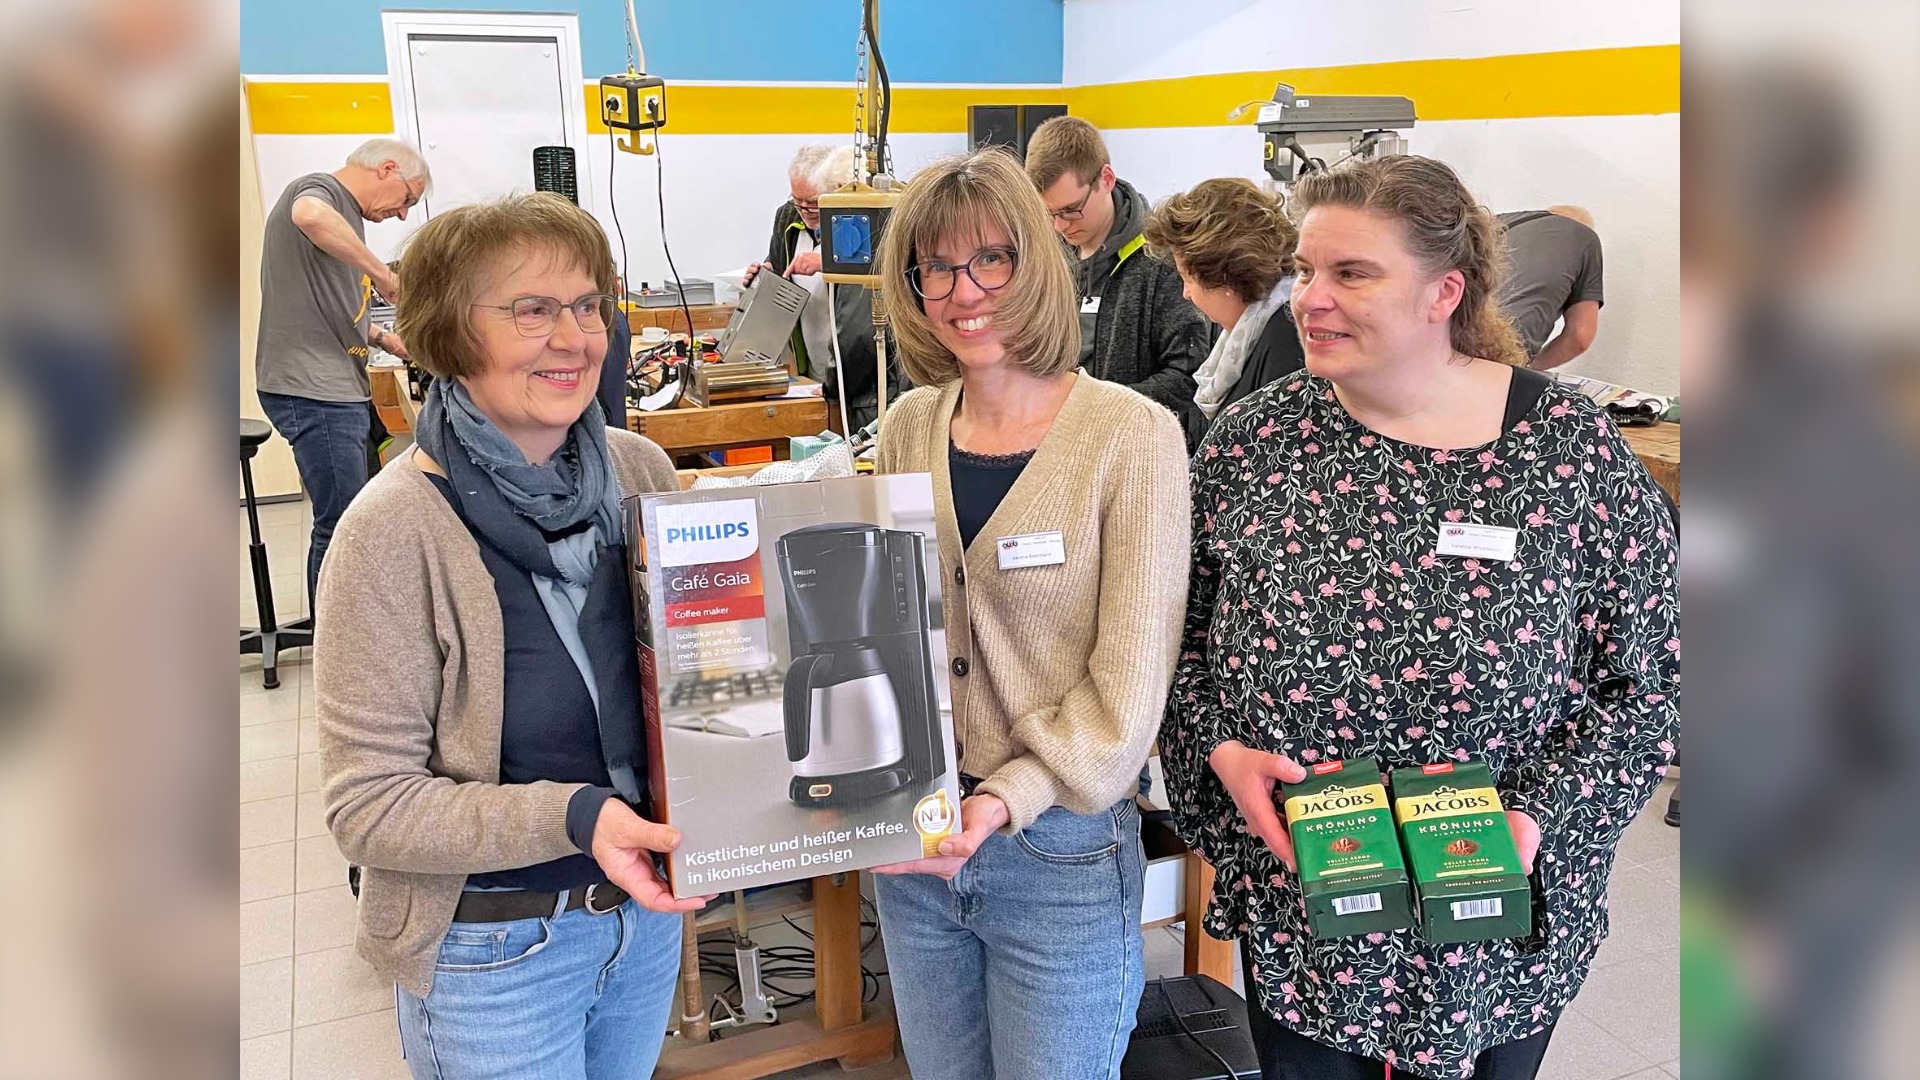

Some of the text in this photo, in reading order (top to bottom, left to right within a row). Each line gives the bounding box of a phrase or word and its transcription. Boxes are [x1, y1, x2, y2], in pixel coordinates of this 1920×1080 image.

[666, 521, 749, 544] PHILIPS
[671, 571, 751, 591] Café Gaia
[674, 606, 729, 619] Coffee maker
[677, 645, 755, 661] mehr als 2 Stunden
[1301, 792, 1375, 816] JACOBS
[1411, 795, 1490, 817] JACOBS
[1306, 815, 1377, 832] KRÖNUNG
[1419, 818, 1494, 834] KRÖNUNG
[685, 844, 766, 867] Köstlicher
[769, 836, 799, 853] und
[803, 830, 852, 848] heißer
[855, 822, 908, 840] Kaffee,
[687, 848, 853, 885] in ikonischem Design
